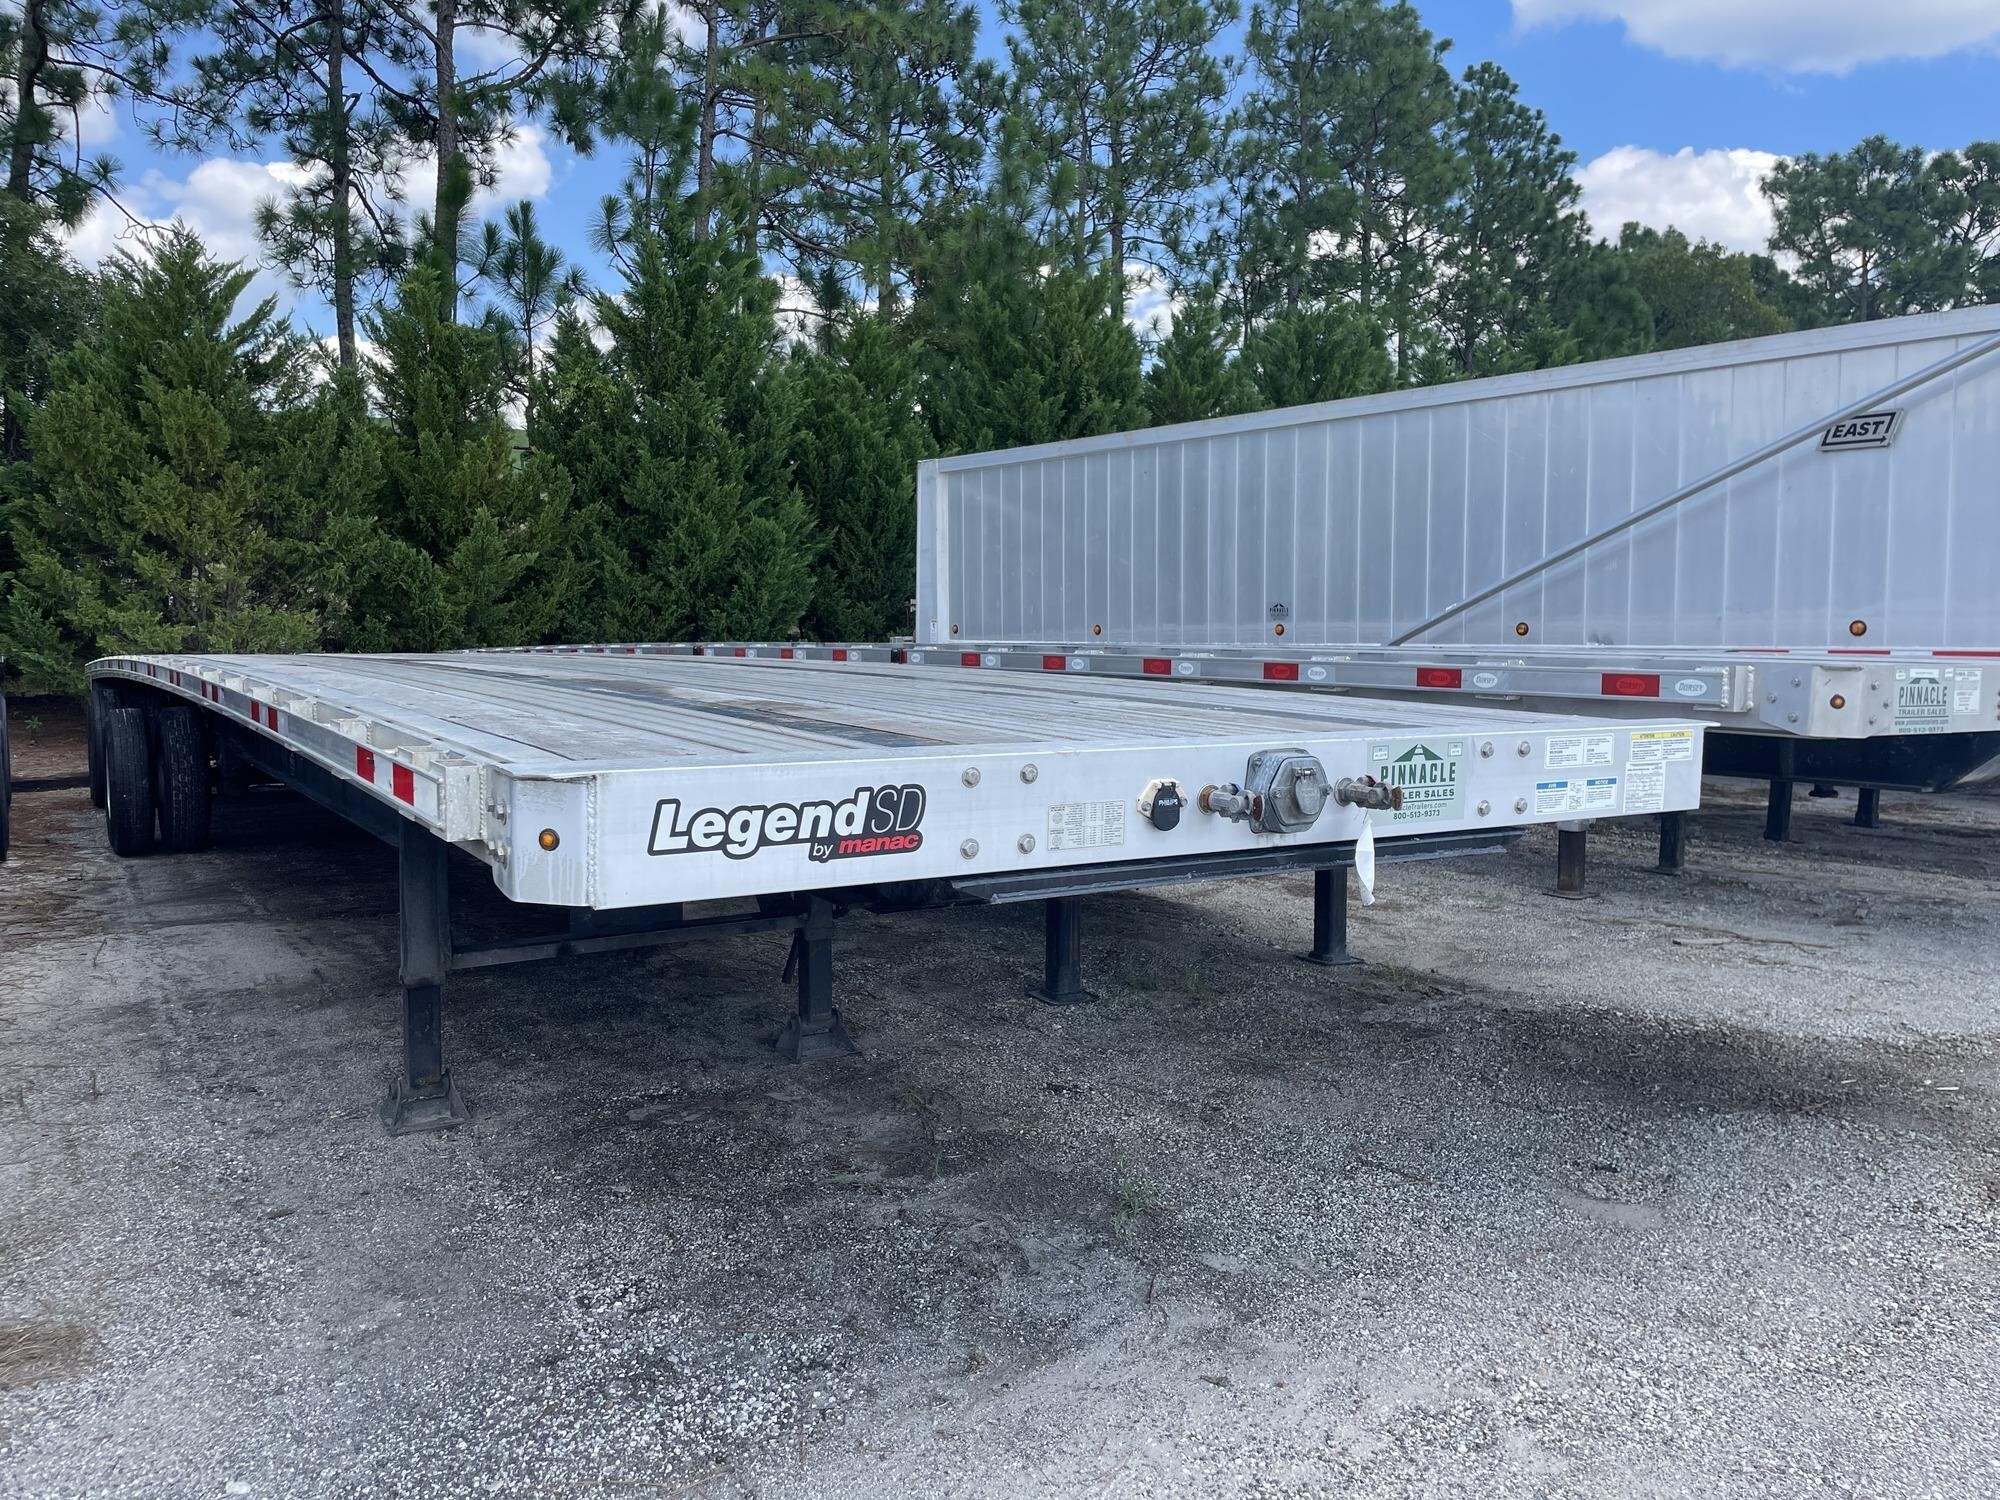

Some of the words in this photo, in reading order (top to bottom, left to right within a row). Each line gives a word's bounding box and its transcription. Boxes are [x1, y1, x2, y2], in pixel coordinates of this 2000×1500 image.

[1832, 421, 1885, 438] EAST
[1678, 682, 1704, 692] DORSEY
[1899, 686, 1948, 705] PINNACLE
[1380, 762, 1456, 786] PINNACLE
[1424, 788, 1455, 799] SALES
[1393, 809, 1441, 820] 800-513-9373
[812, 843, 834, 859] by
[838, 833, 920, 854] manac
